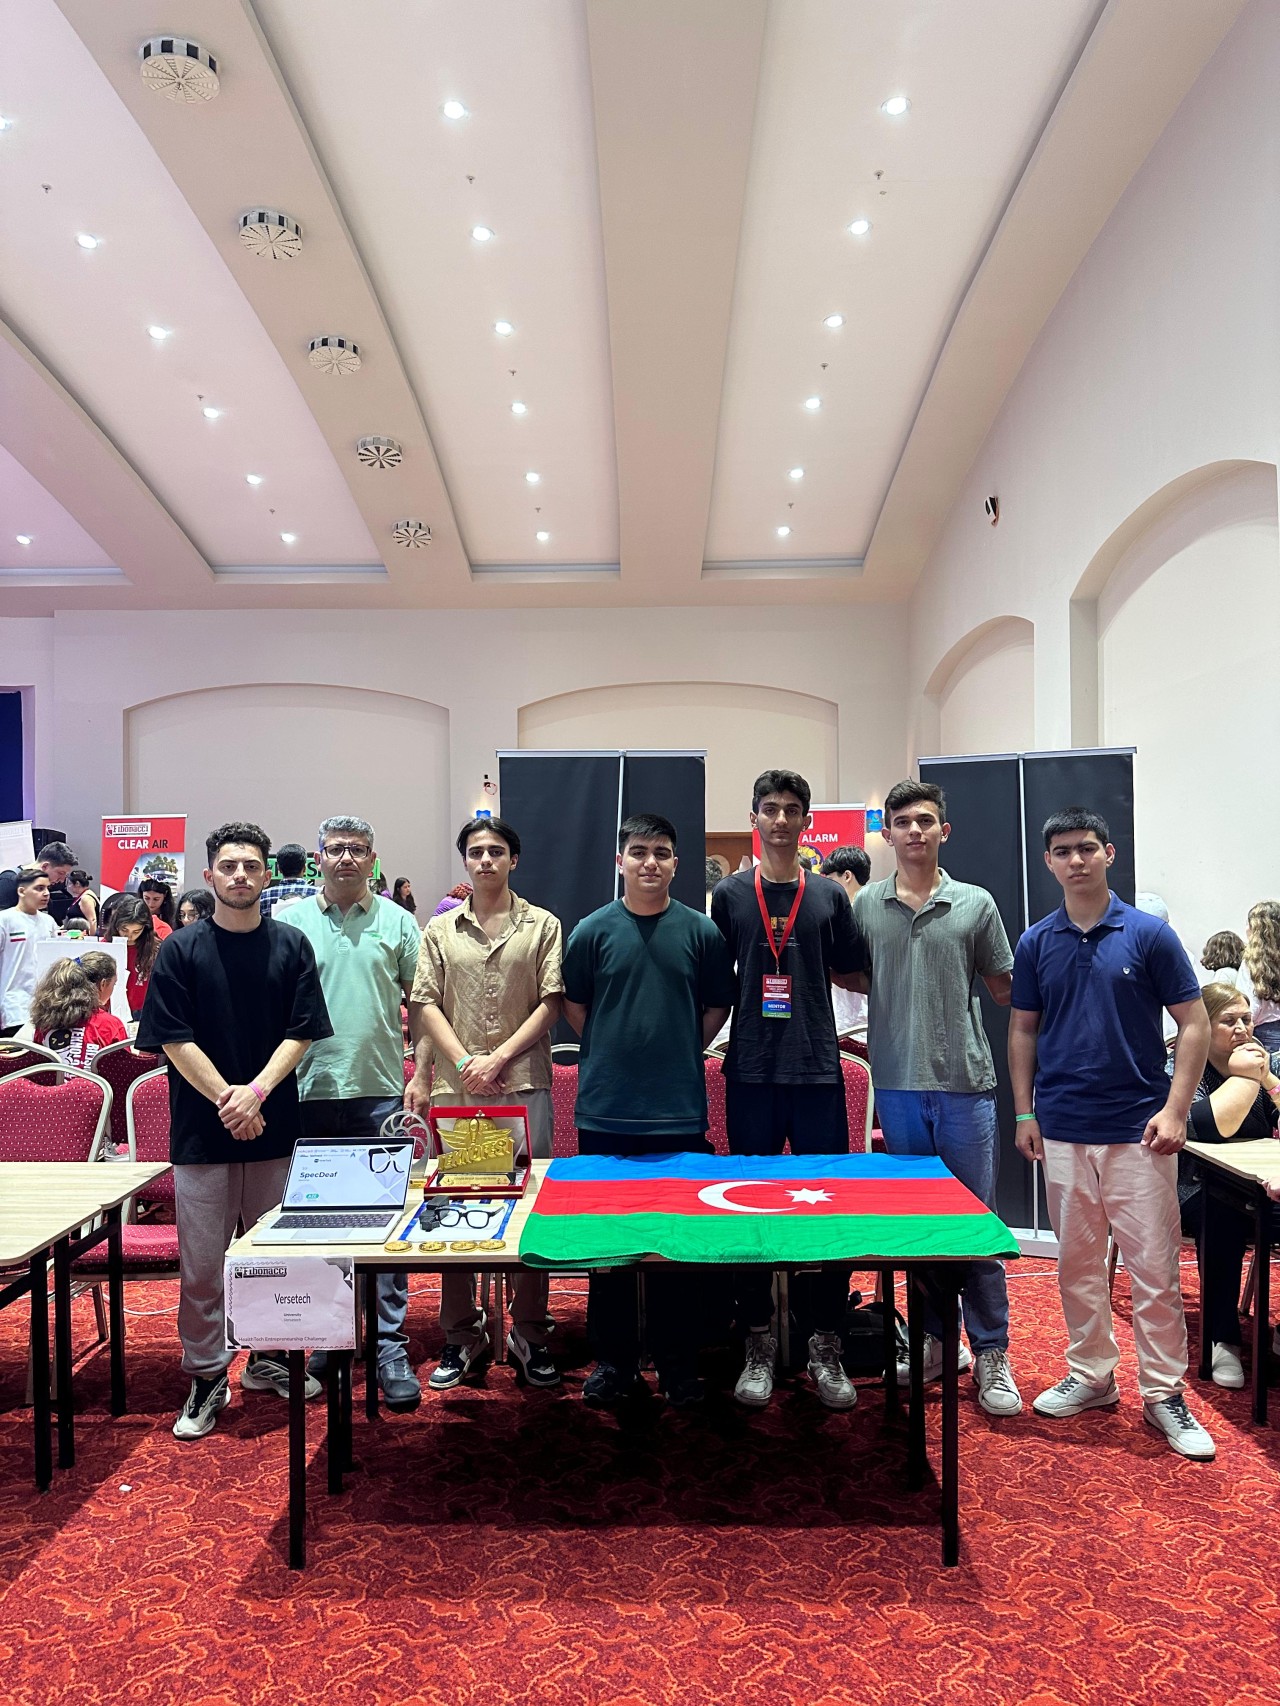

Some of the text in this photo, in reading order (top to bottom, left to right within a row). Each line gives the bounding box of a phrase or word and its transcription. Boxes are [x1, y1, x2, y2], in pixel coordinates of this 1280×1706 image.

[802, 834, 838, 843] ALARM
[118, 839, 168, 850] CLEAR AIR
[300, 1171, 338, 1179] SpecDeaf
[274, 1293, 311, 1304] Versetech
